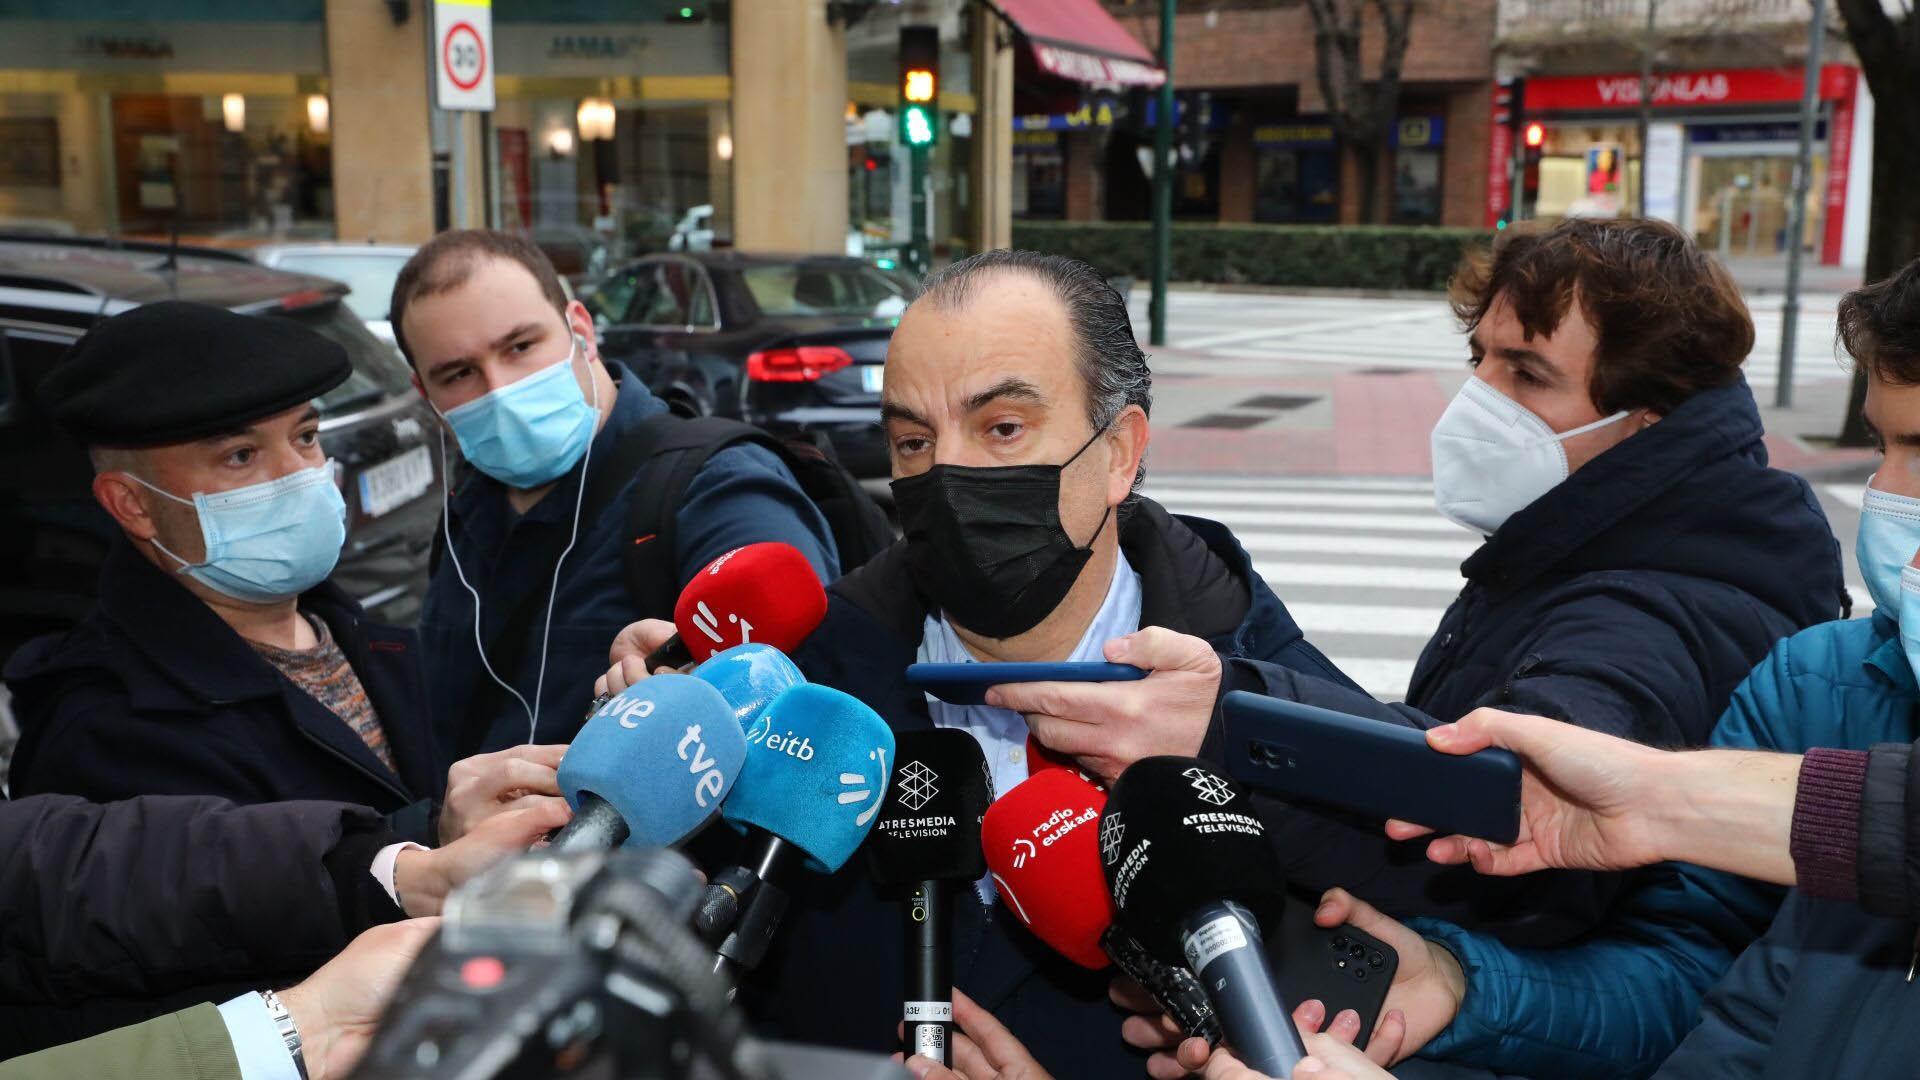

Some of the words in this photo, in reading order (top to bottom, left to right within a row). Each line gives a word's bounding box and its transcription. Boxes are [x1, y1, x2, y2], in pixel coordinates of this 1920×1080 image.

[453, 45, 477, 67] 30
[766, 731, 814, 760] eitb
[677, 724, 723, 807] tve
[879, 816, 956, 830] ATRESMEDIA
[1033, 809, 1073, 837] radio
[1043, 808, 1098, 846] euskadi
[1183, 813, 1264, 830] ATRESMEDIA
[1196, 823, 1260, 836] TELEVISIÓN
